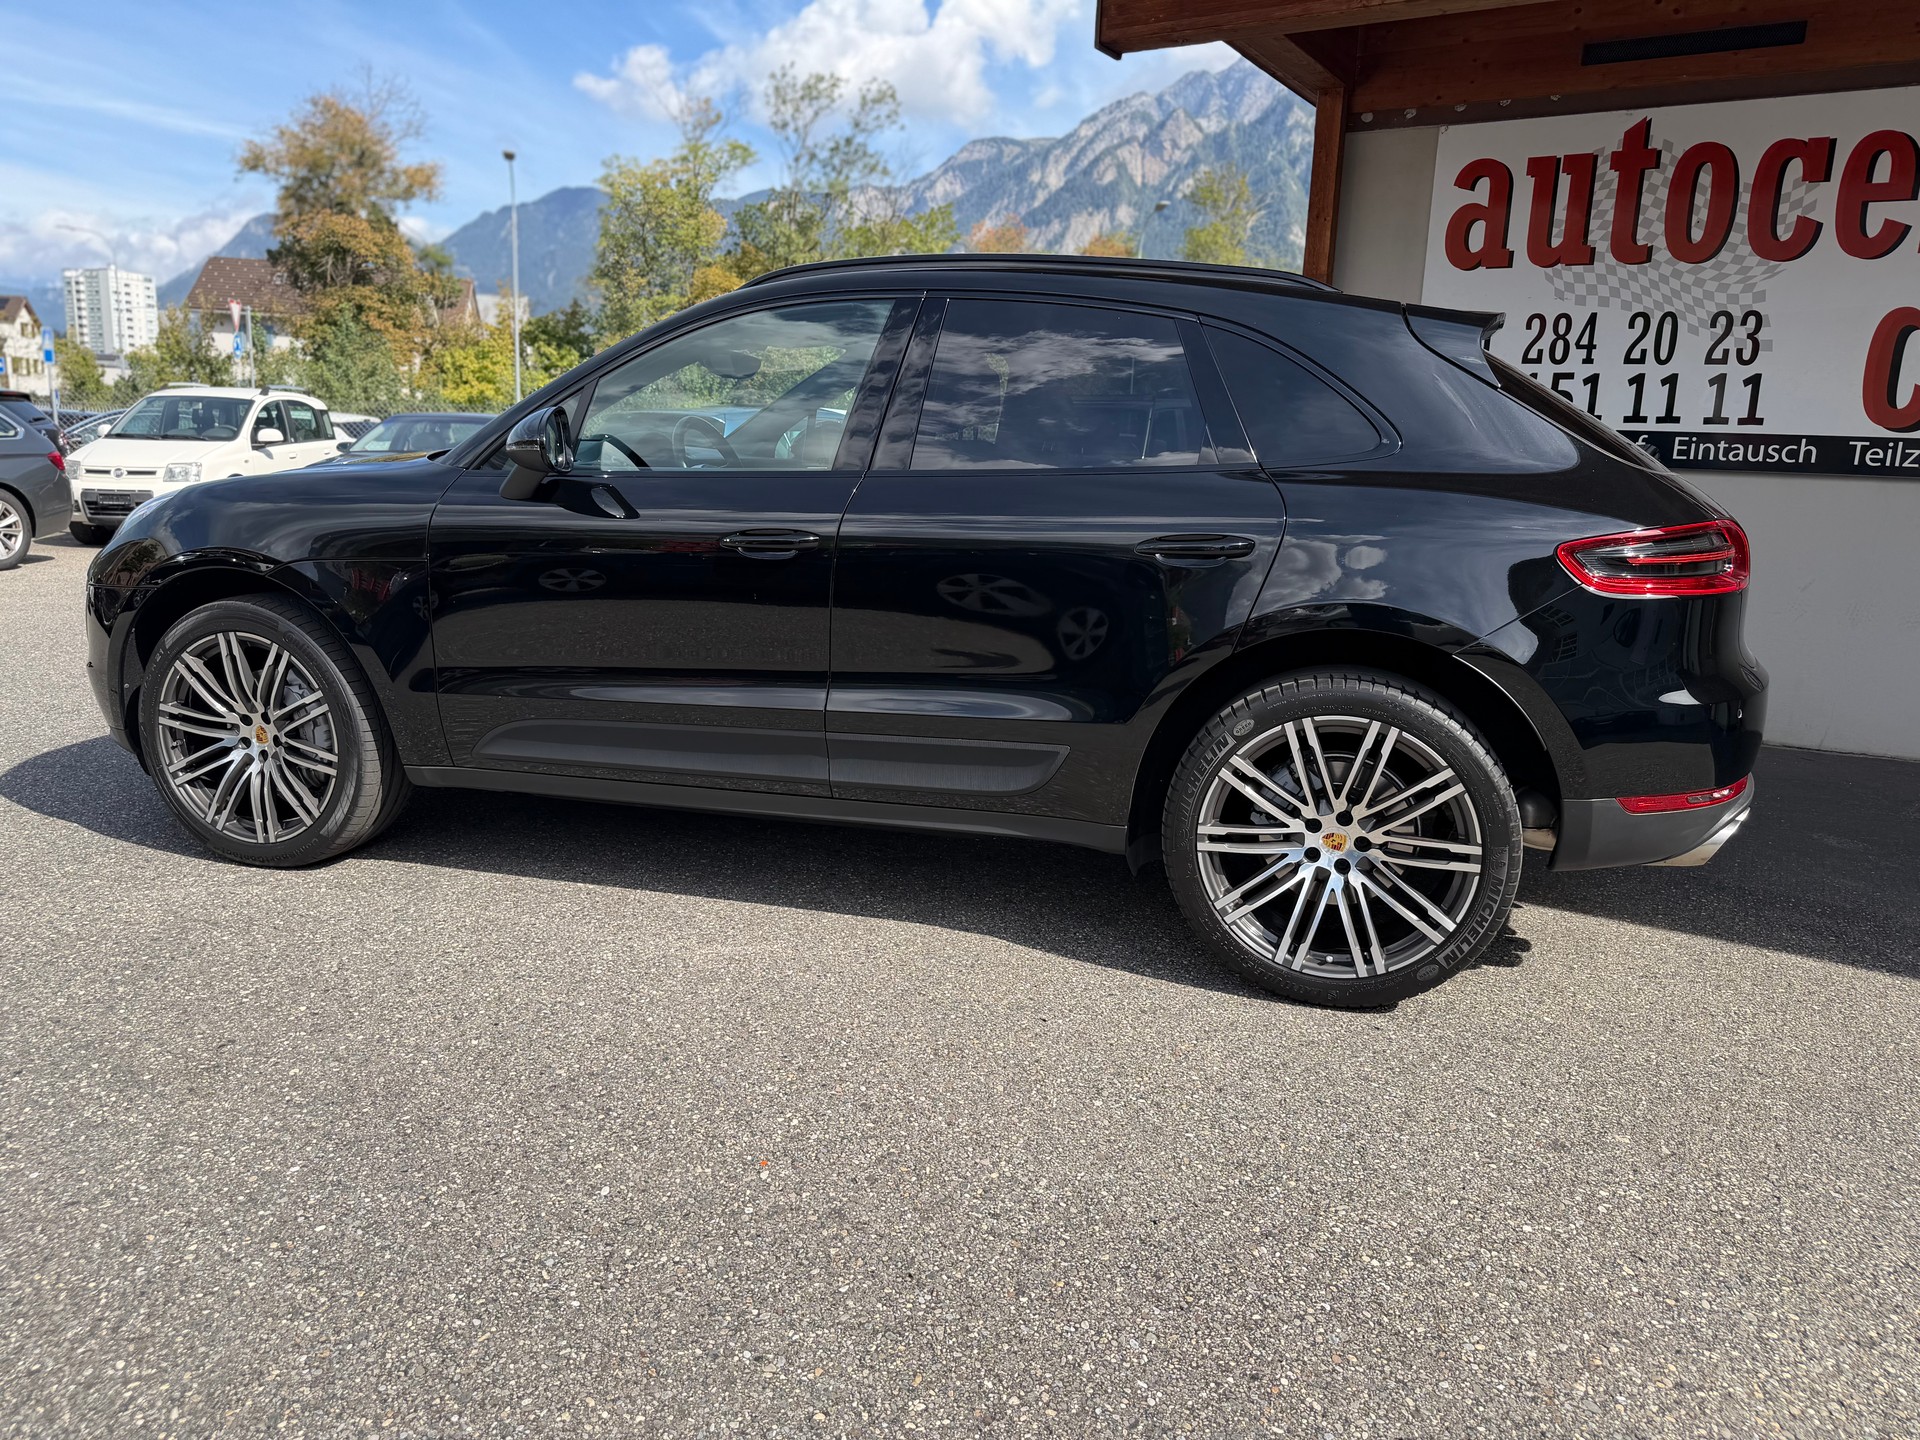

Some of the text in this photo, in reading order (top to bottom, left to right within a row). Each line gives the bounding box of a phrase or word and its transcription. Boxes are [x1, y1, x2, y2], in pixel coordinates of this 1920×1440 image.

[1445, 115, 1920, 270] autoce
[1521, 310, 1763, 365] 284 20 23
[1529, 372, 1765, 426] 51 11 11
[1672, 436, 1818, 465] Eintausch
[1849, 441, 1920, 468] Teilz
[1442, 877, 1504, 967] MICHELIN
